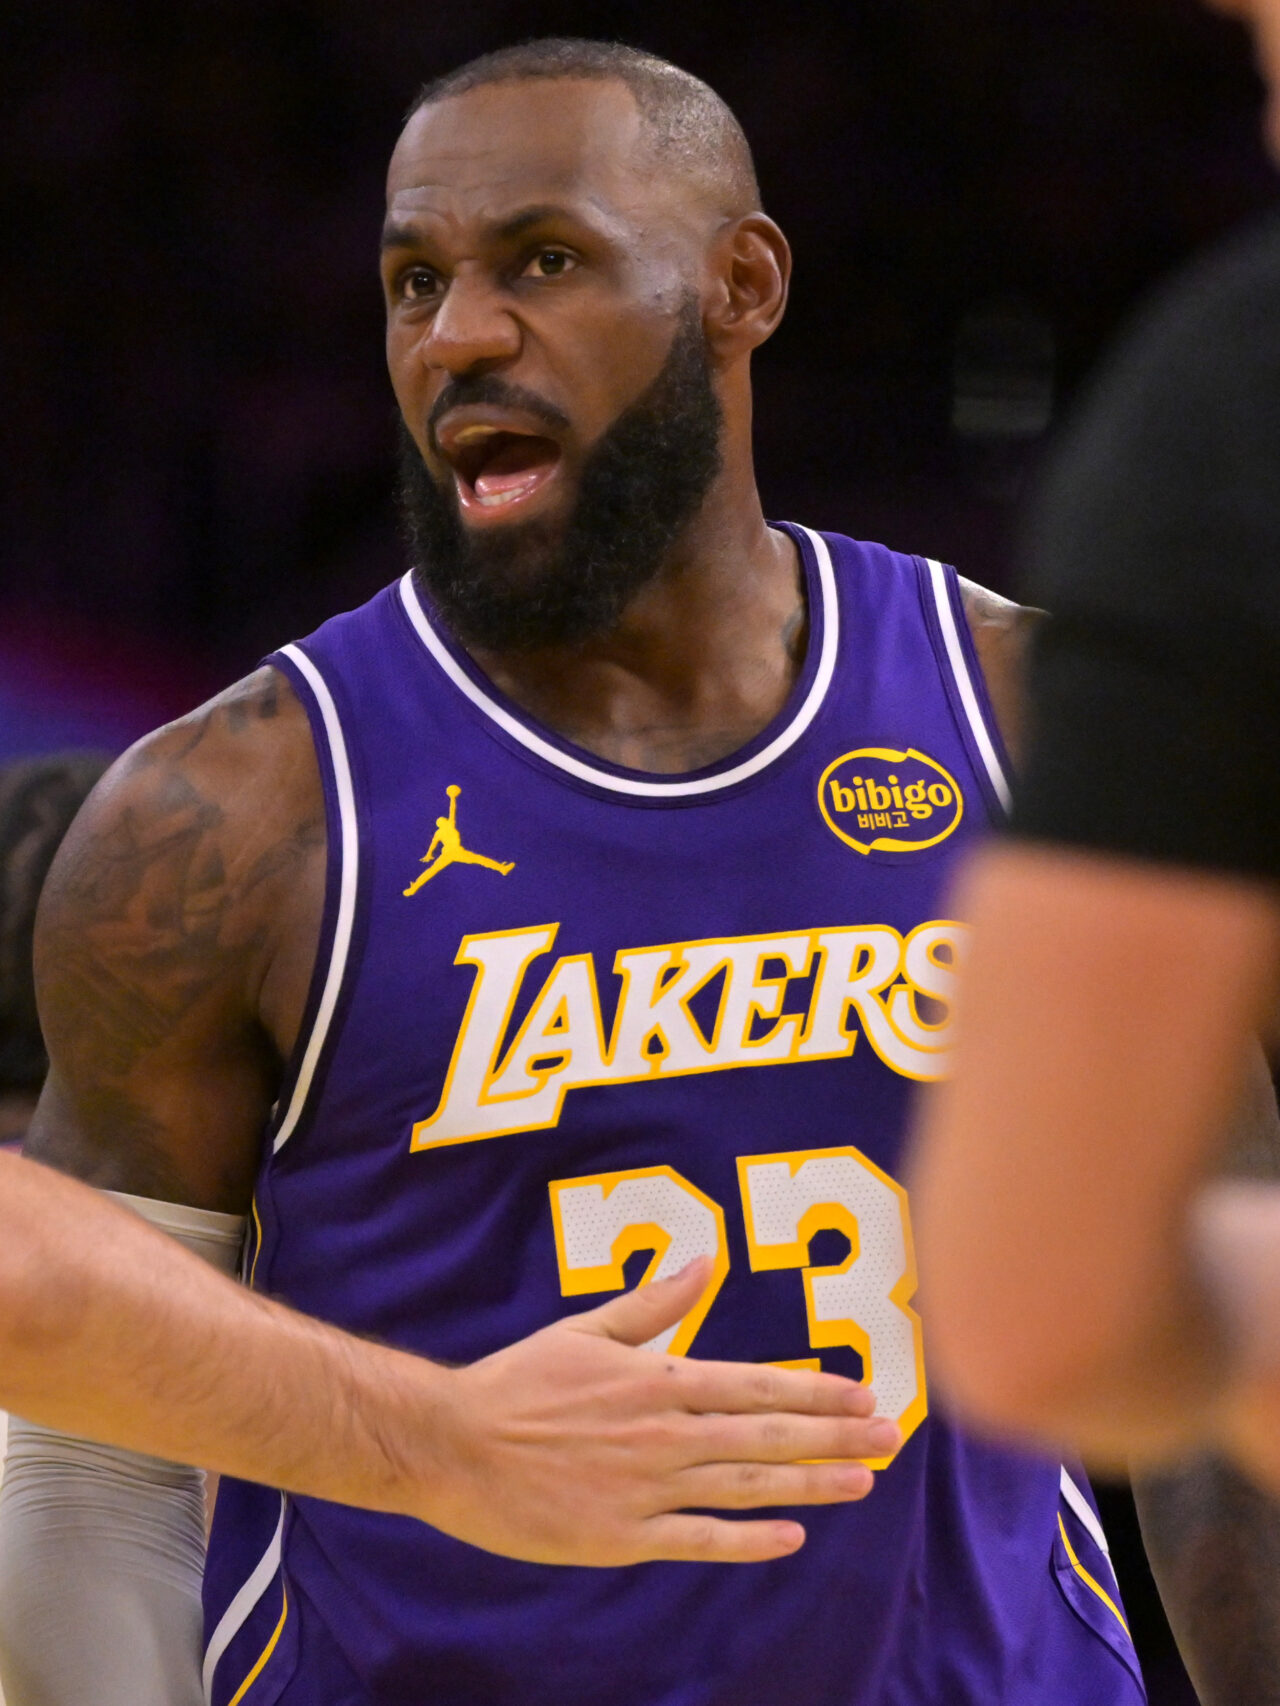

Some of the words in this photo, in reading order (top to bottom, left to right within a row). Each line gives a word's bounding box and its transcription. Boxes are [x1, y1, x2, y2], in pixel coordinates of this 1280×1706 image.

[828, 774, 953, 820] bibigo
[856, 811, 910, 831] 비비고
[409, 920, 970, 1153] LAKERS
